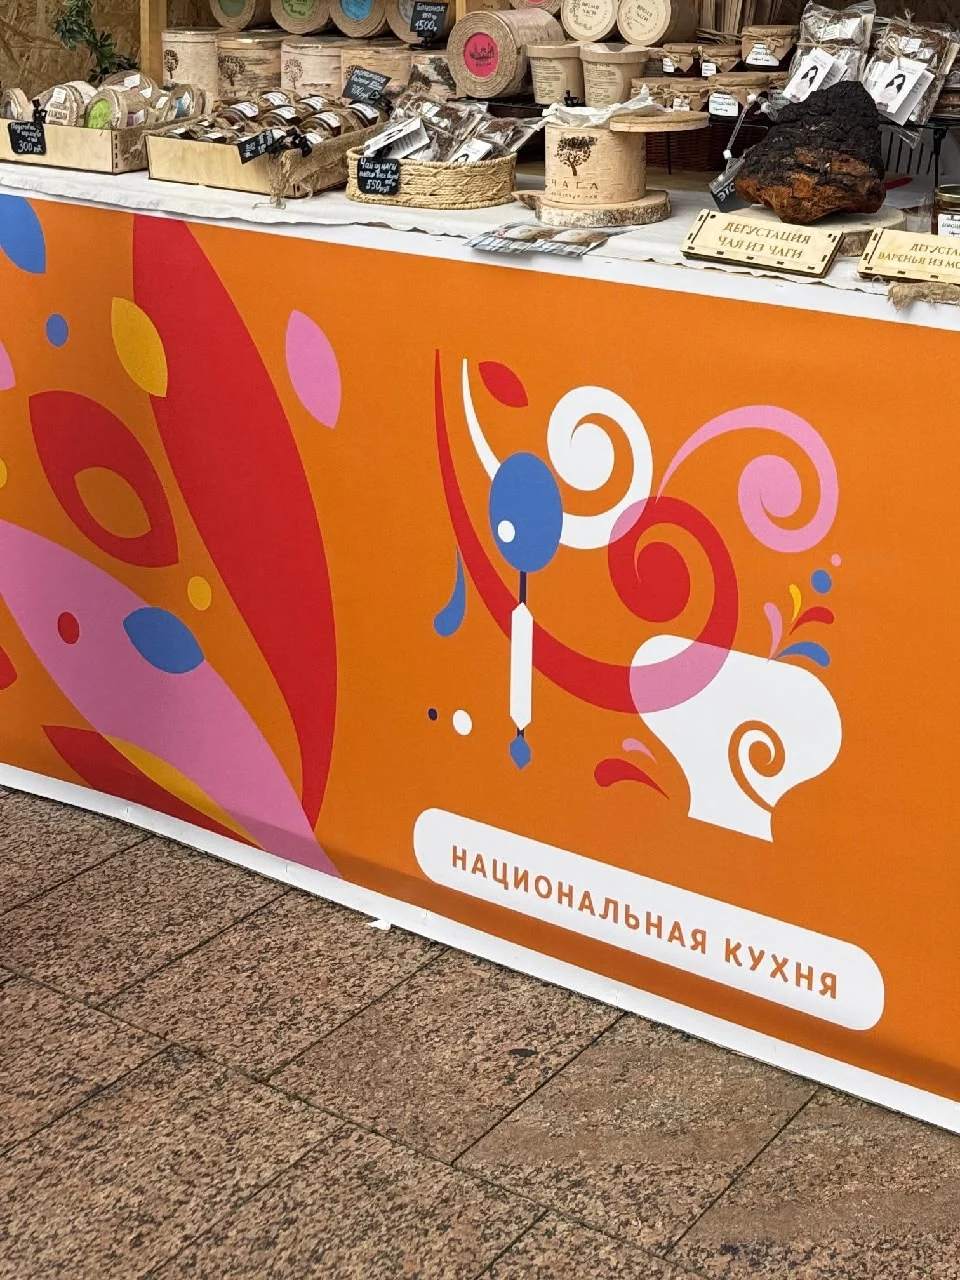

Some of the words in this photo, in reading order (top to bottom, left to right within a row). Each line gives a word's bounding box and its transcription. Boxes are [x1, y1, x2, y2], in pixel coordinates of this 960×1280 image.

[722, 222, 811, 245] ДЕГУСТАЦИЯ
[718, 235, 743, 249] ЧАЯ
[745, 241, 764, 252] ИЗ
[769, 245, 803, 259] ЧАГИ
[877, 251, 927, 266] ВАРЕНЬЯ
[927, 257, 943, 267] ИЗ
[451, 844, 707, 955] НАЦИОНАЛЬНАЯ
[725, 937, 838, 1000] КУХНЯ
